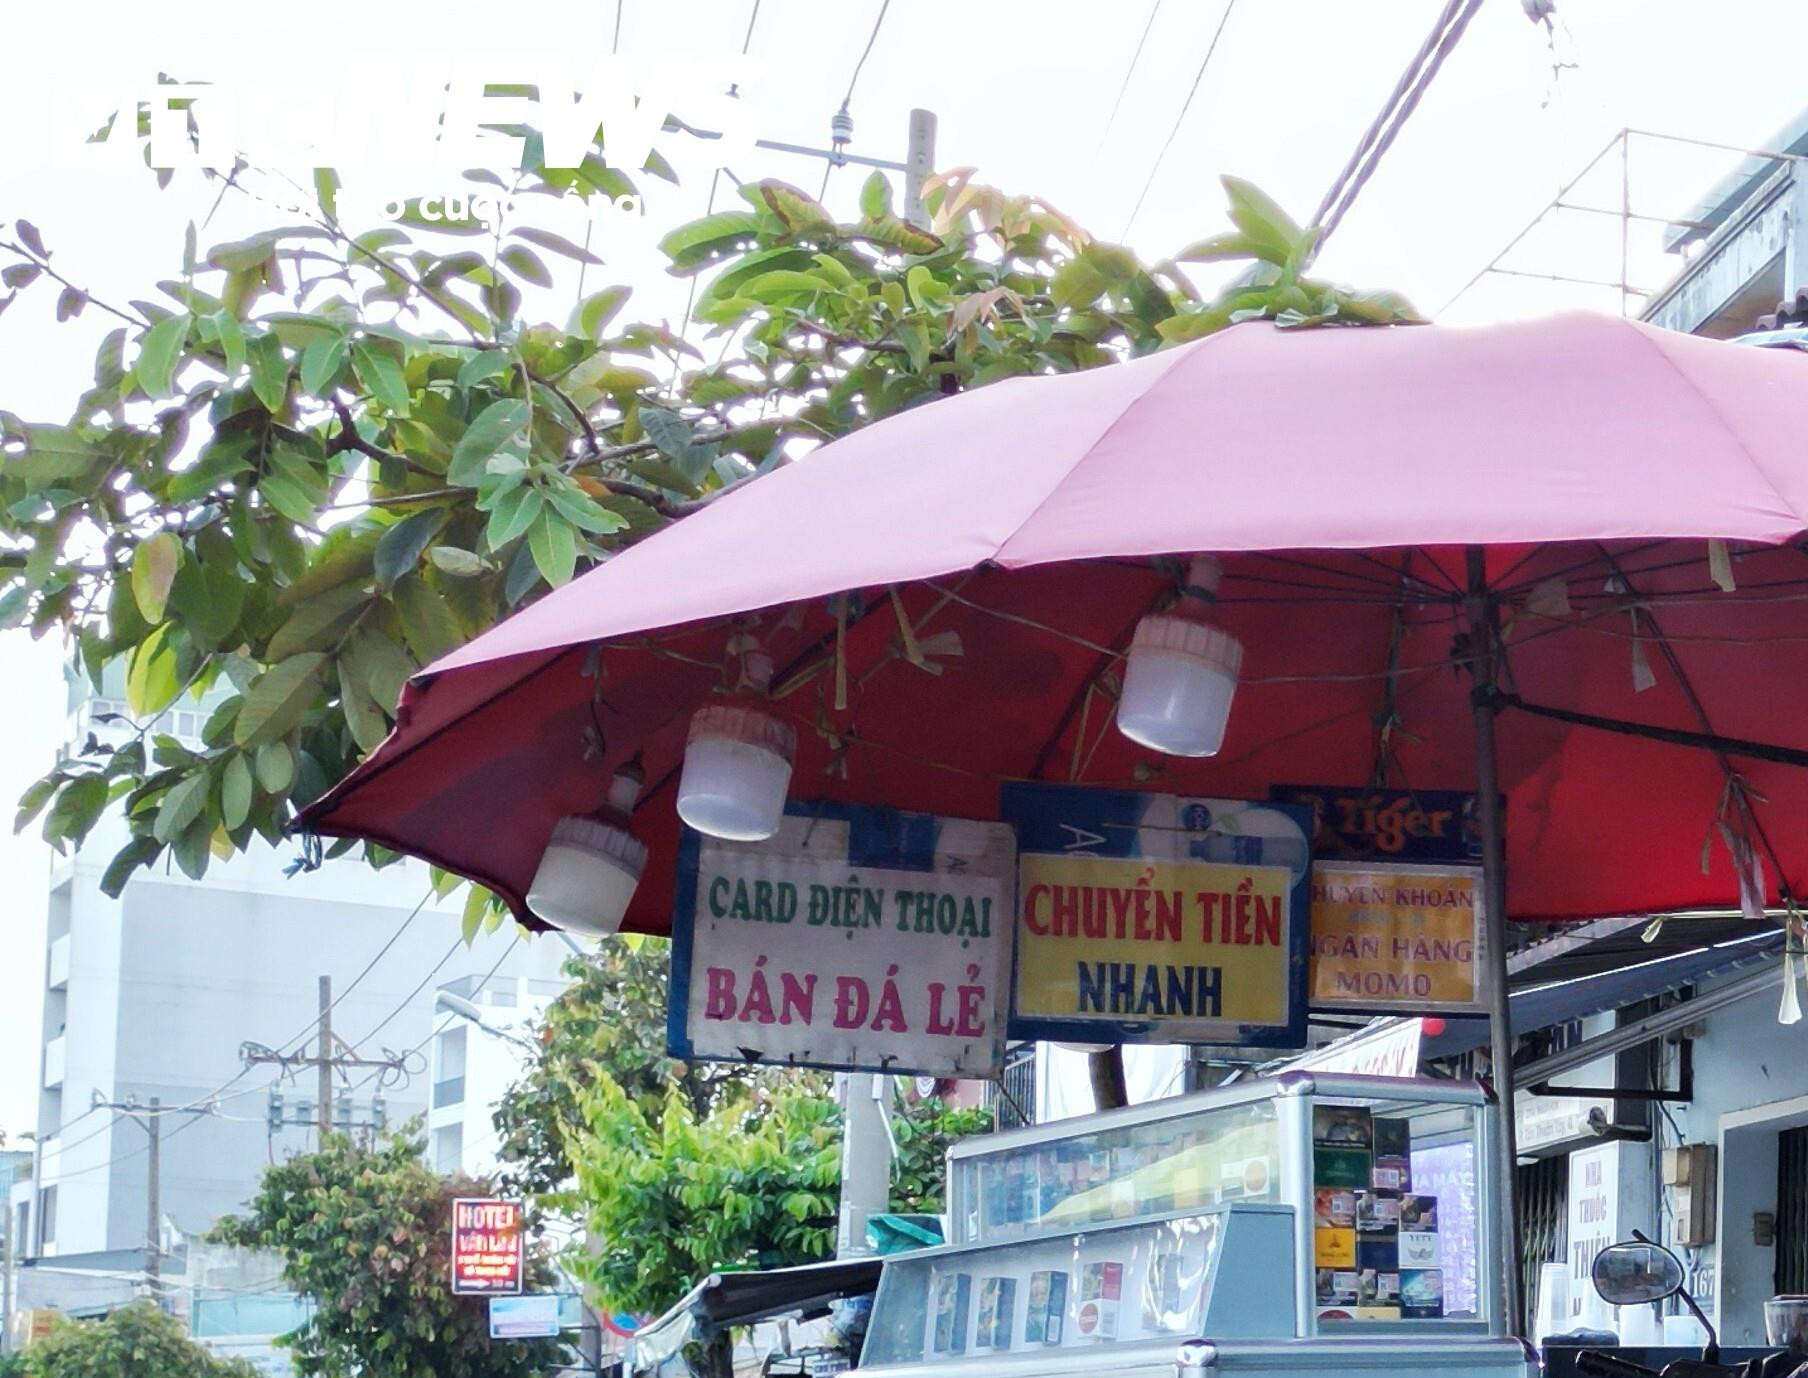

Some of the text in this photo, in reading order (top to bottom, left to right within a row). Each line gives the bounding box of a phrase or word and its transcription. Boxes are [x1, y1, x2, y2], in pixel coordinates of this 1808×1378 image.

[1335, 796, 1453, 852] Tiger
[709, 875, 993, 949] CARD ĐIỆN THOẠI
[1024, 867, 1183, 942] CHUYỂN
[1393, 931, 1473, 963] HÀNG
[704, 955, 986, 1038] BÁN ĐÁ LẺ
[1078, 961, 1222, 1017] NHANH
[1337, 972, 1431, 996] MOMO
[1692, 1270, 1714, 1299] 167
